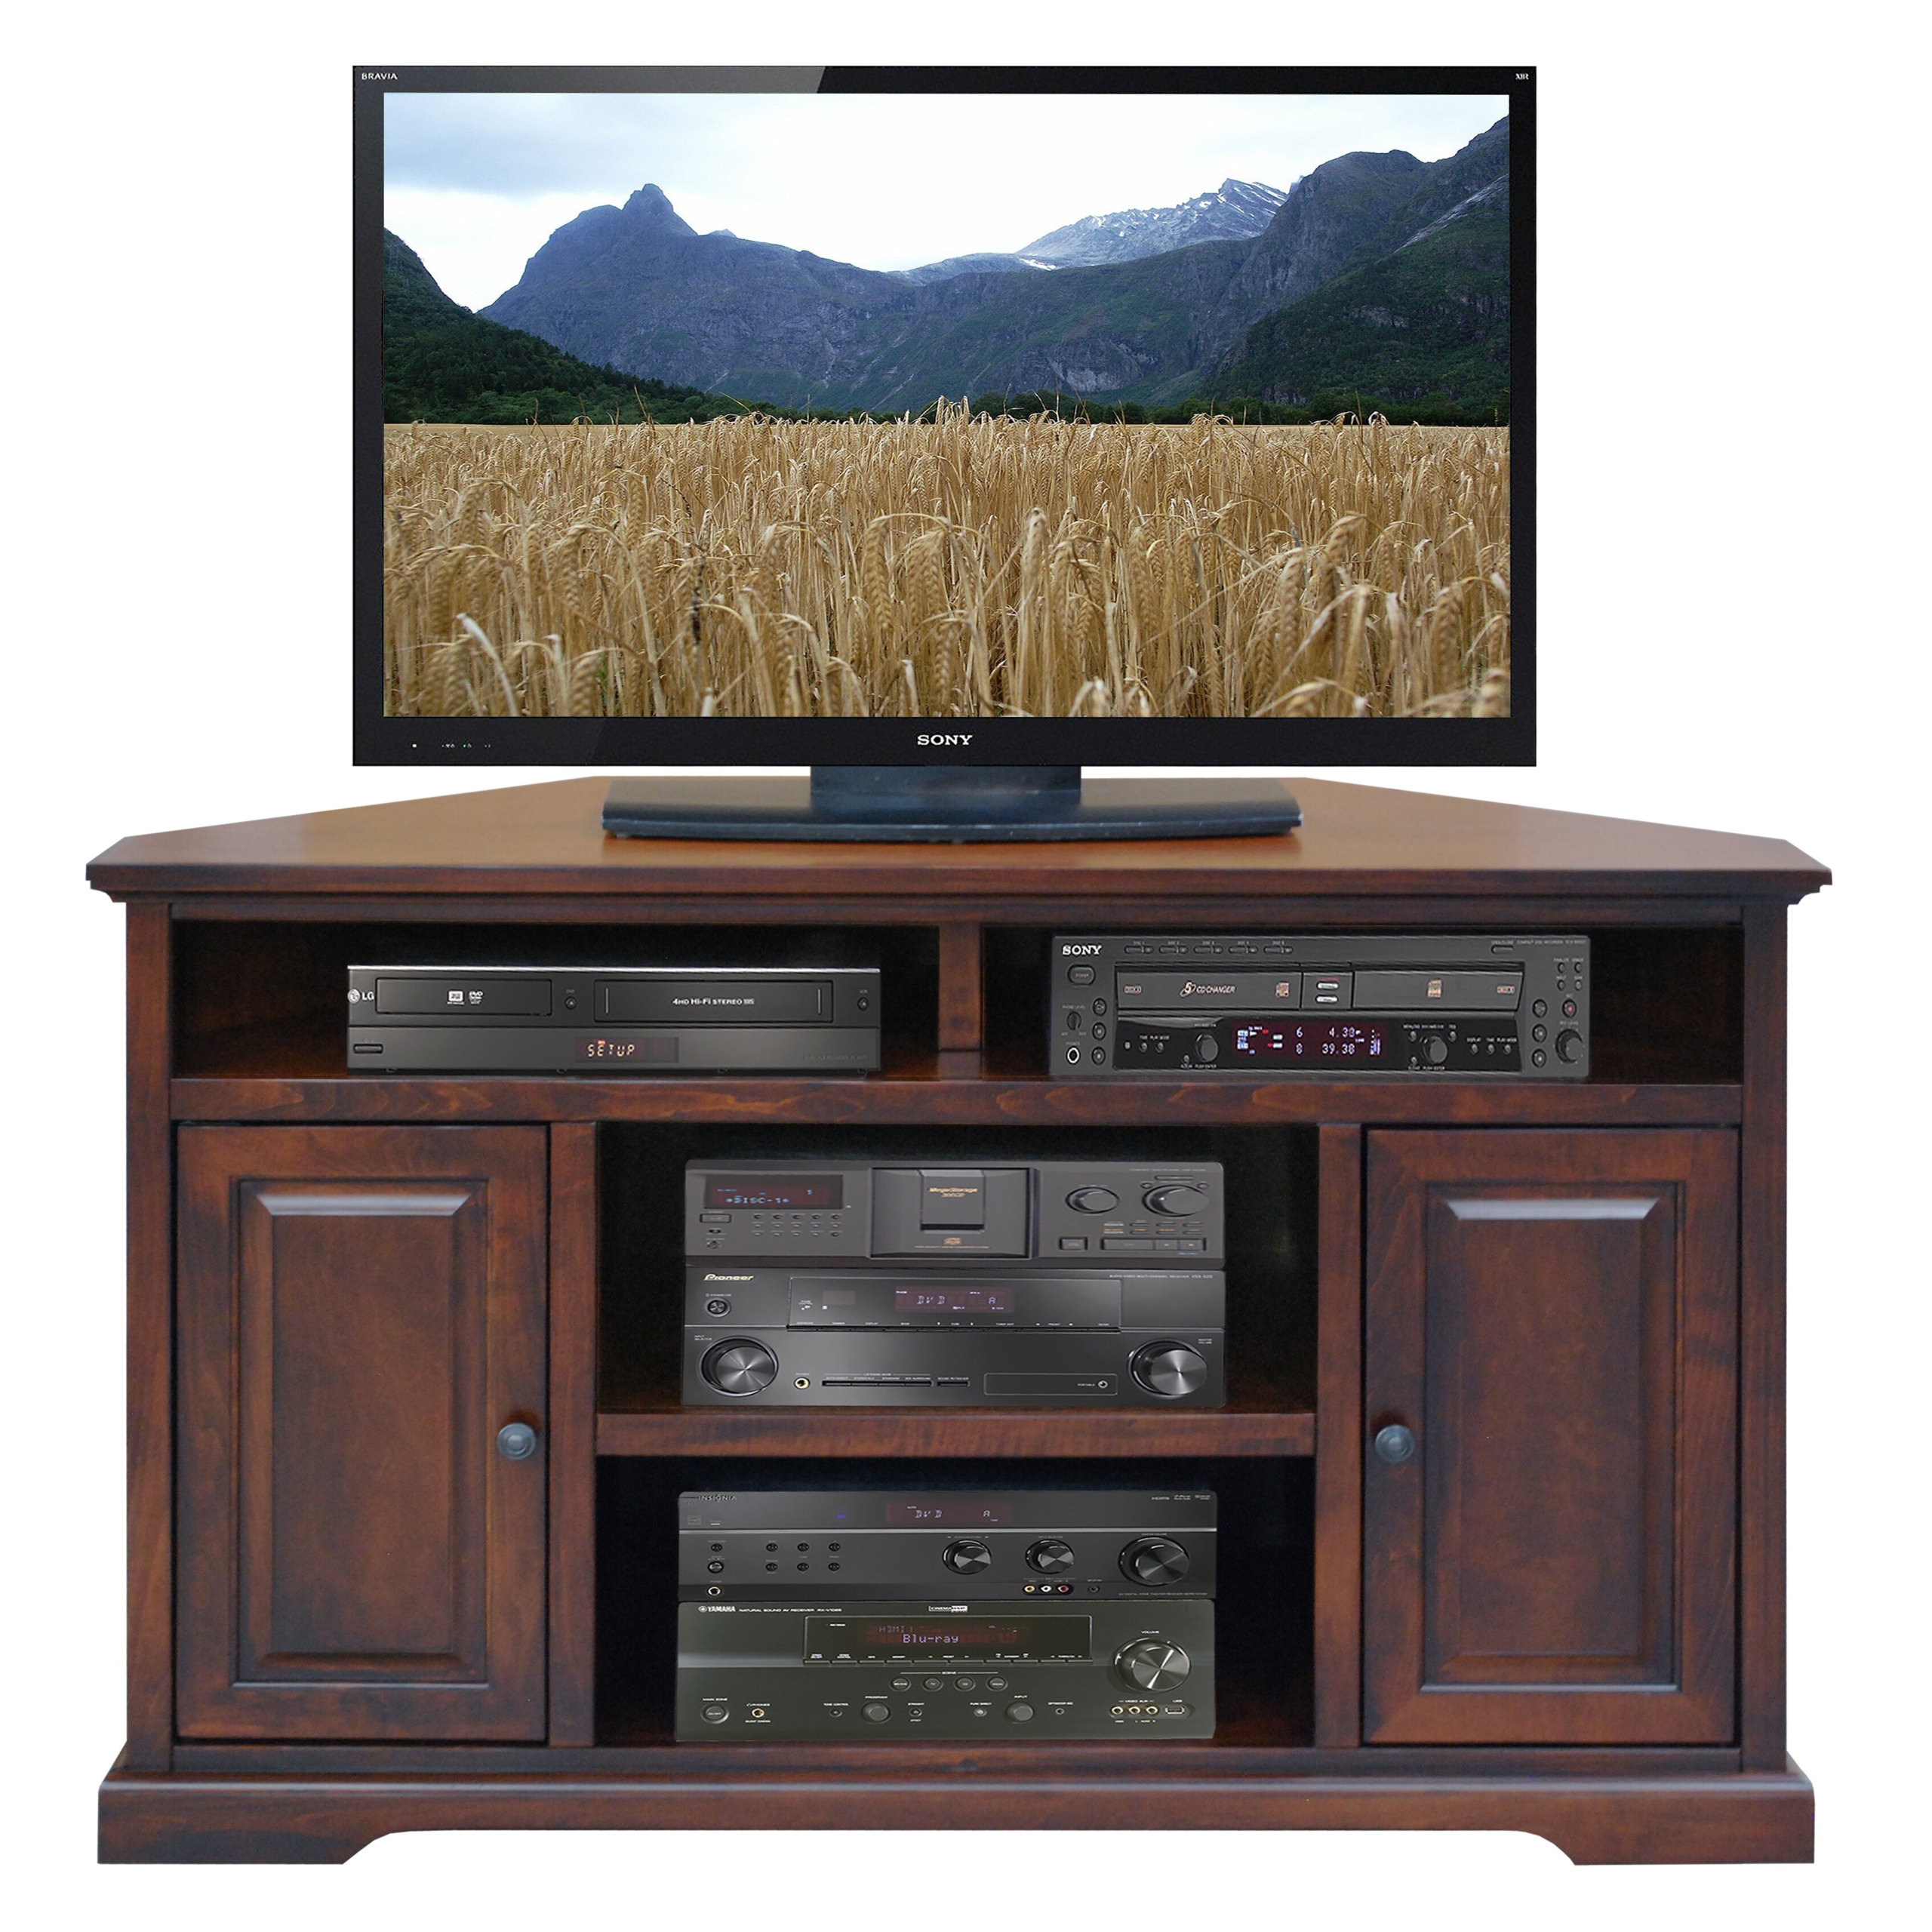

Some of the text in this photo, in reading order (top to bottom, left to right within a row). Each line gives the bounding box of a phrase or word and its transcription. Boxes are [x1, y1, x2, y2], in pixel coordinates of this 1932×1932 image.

[917, 734, 973, 746] SONY
[1062, 945, 1102, 956] SONY
[361, 991, 374, 1001] LG
[1296, 1026, 1303, 1038] 6
[588, 1044, 635, 1057] SETUP
[703, 1273, 755, 1281] Pioneer
[903, 1634, 959, 1644] Blu-ray
